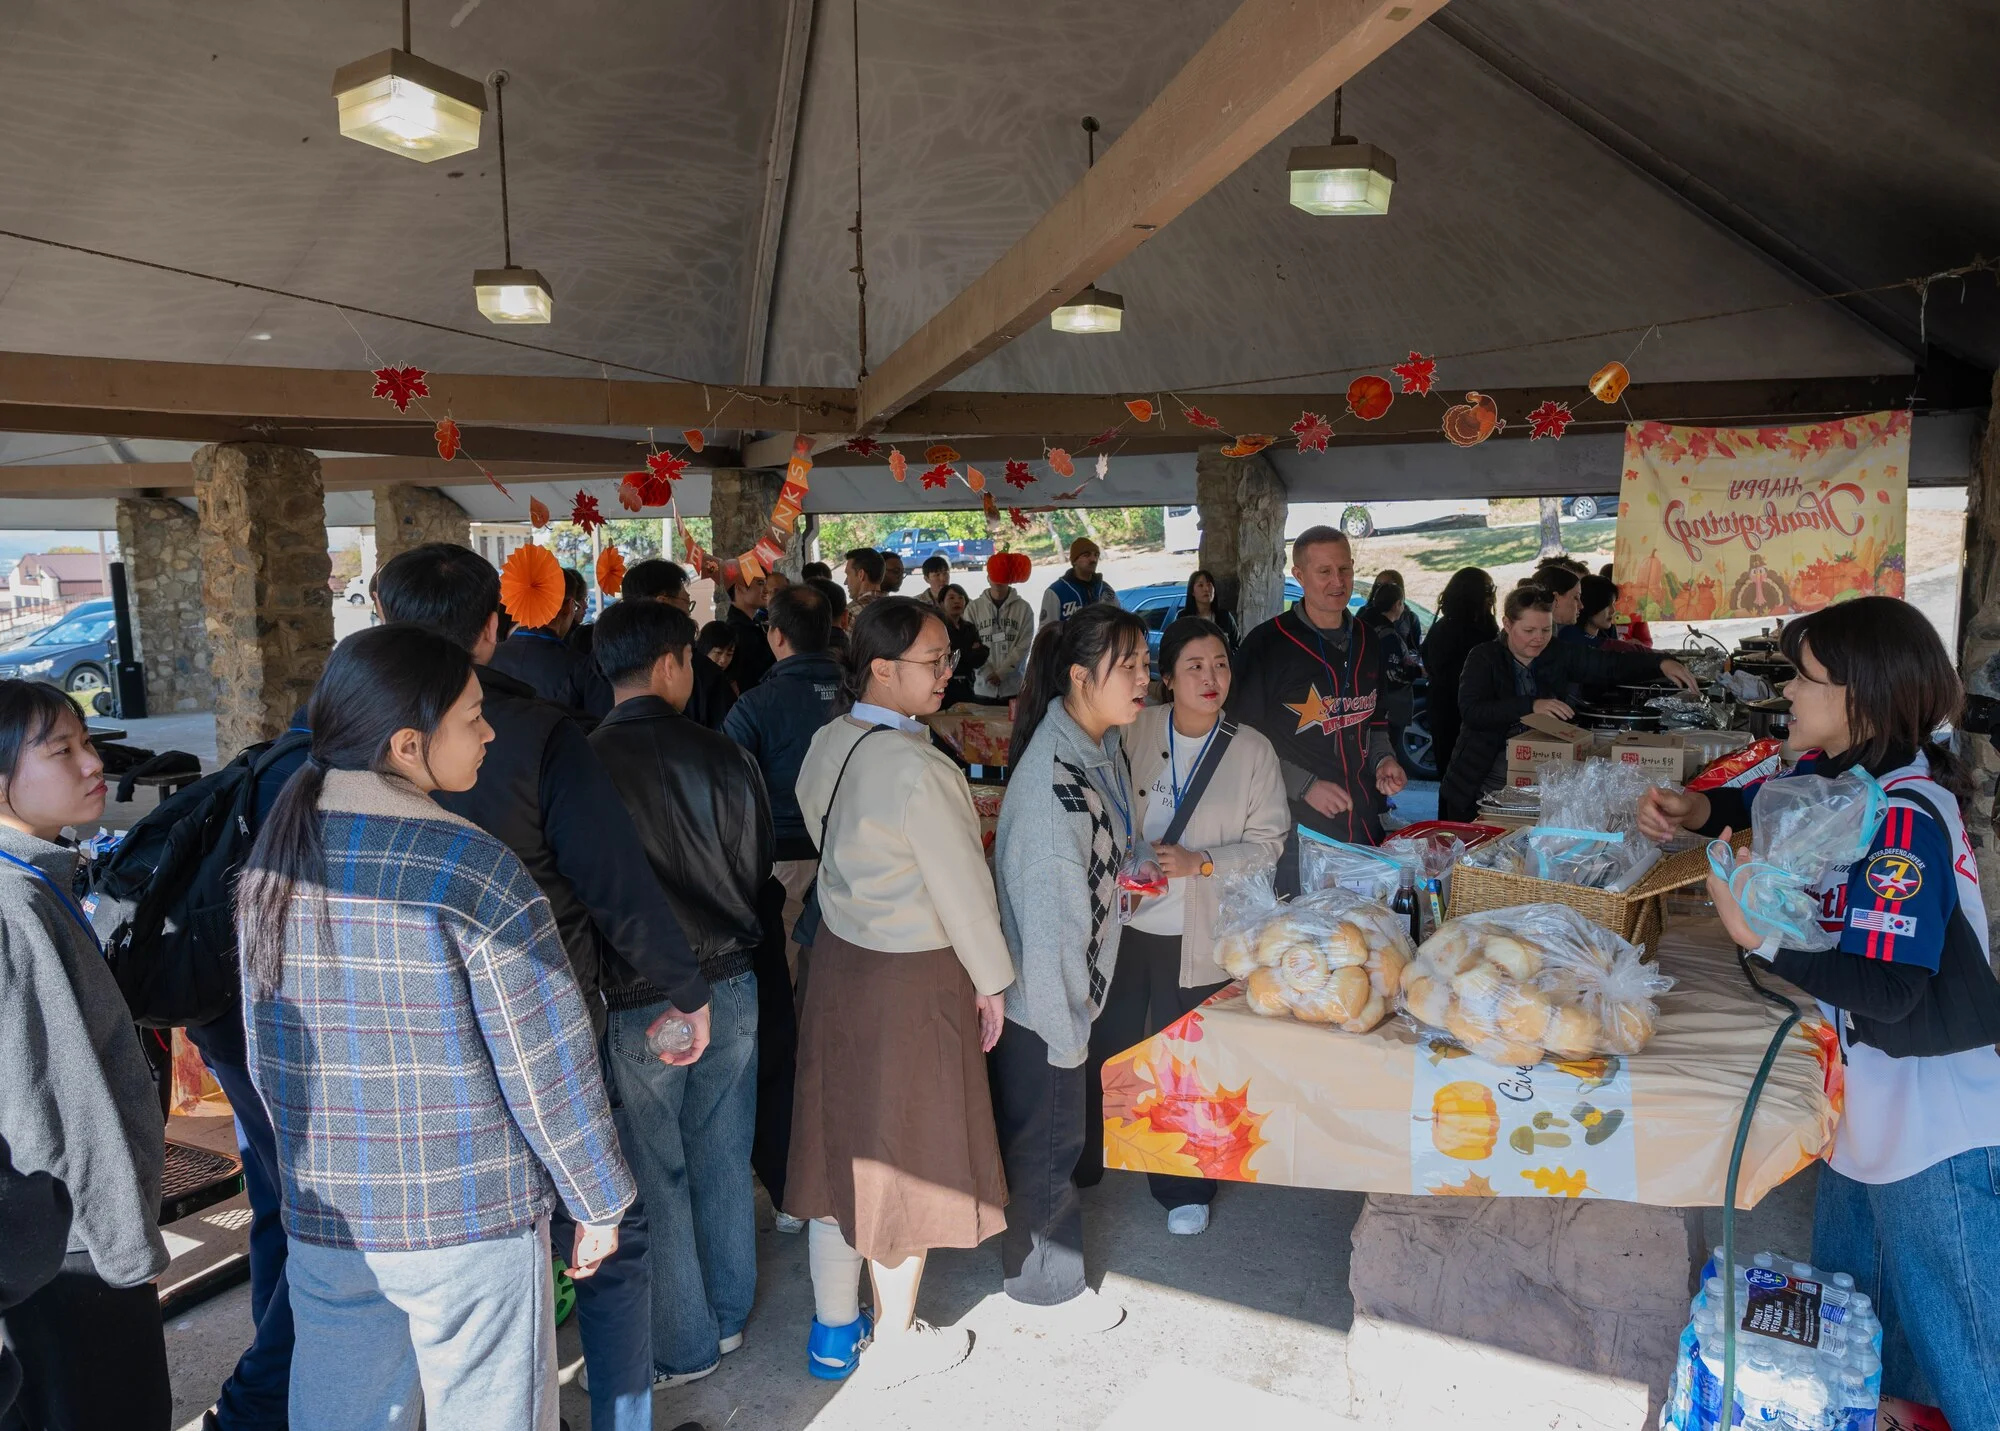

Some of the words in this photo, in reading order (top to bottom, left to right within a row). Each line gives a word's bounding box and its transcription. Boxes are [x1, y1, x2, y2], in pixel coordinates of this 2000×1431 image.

[741, 463, 804, 573] THANKS
[1063, 601, 1083, 617] Th
[1151, 779, 1166, 793] de
[1750, 1268, 1762, 1284] Pure
